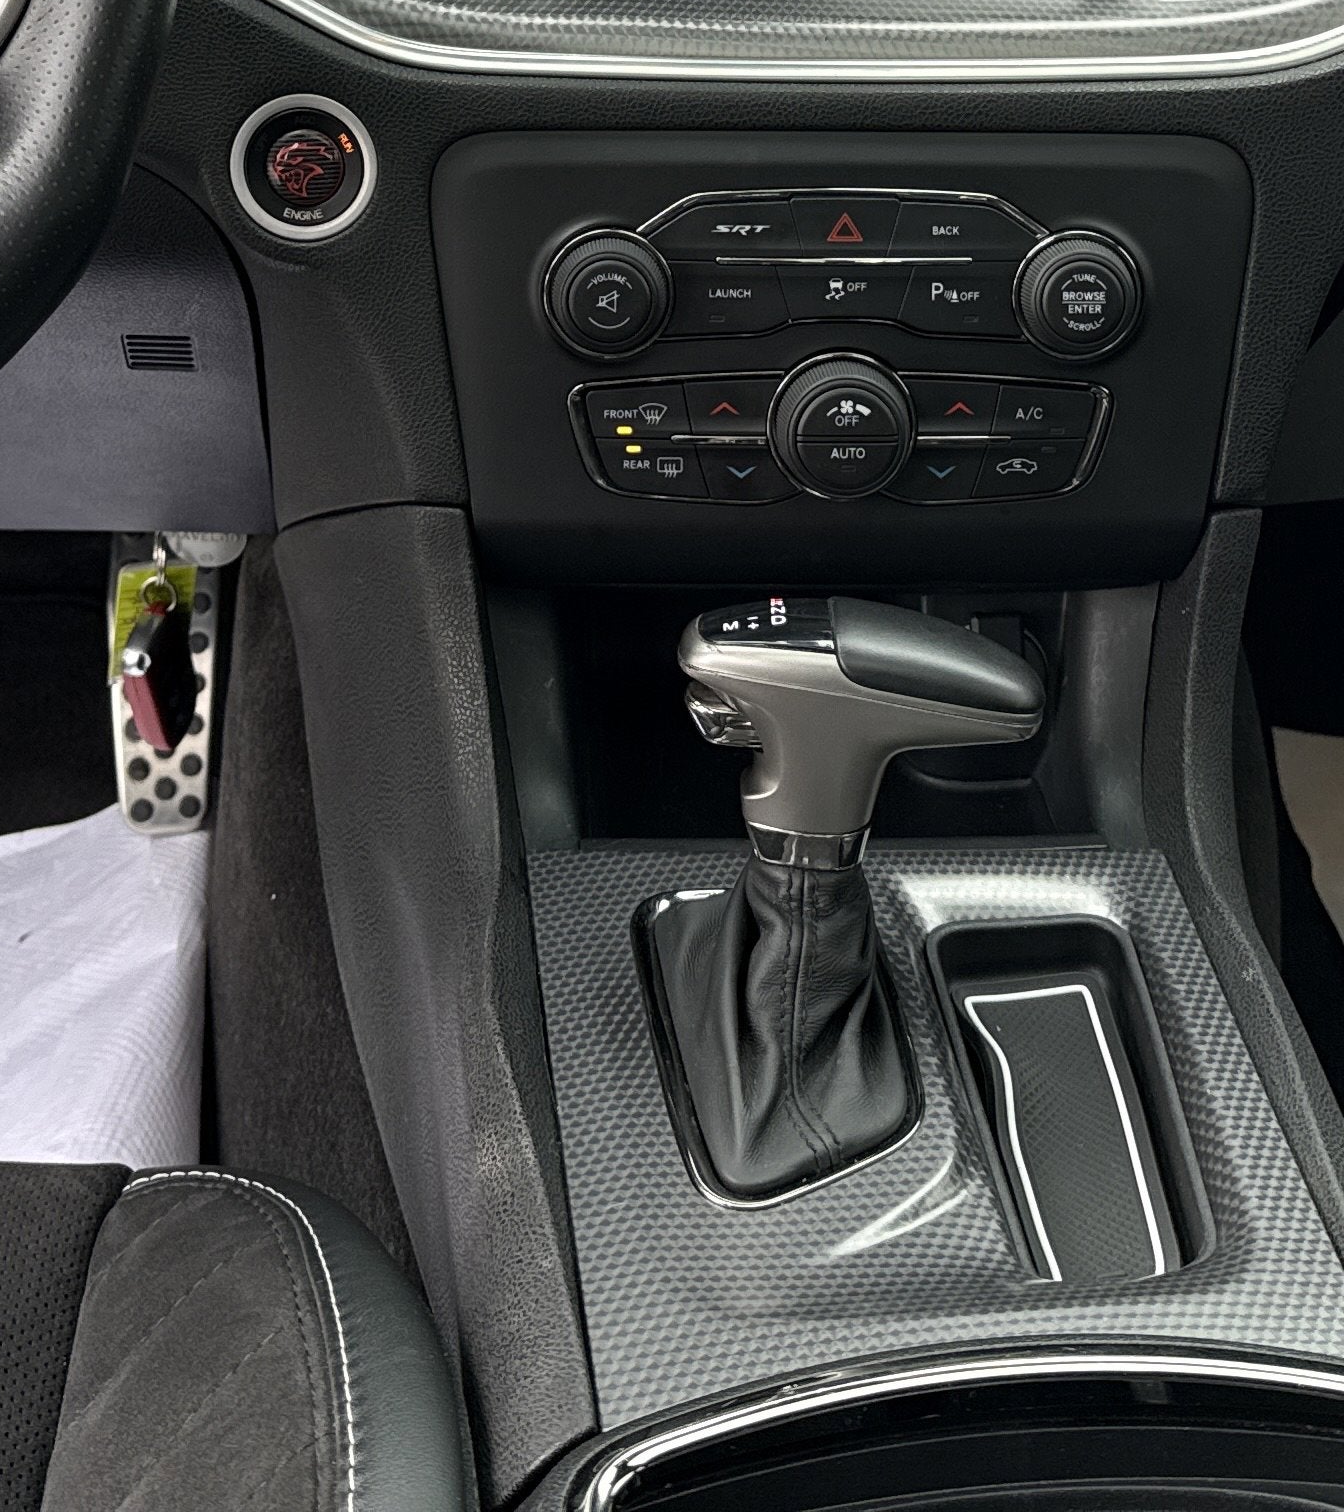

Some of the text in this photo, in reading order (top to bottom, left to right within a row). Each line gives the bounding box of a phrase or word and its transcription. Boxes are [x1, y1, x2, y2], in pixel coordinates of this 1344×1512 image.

[283, 208, 323, 220] ENGINE
[712, 225, 769, 235] SRT
[933, 226, 959, 235] BACK
[589, 273, 630, 287] VOLUME
[1070, 274, 1098, 283] TUNE
[847, 283, 866, 291] OFF
[709, 289, 751, 298] LAUNCH
[958, 292, 979, 302] OFF
[1063, 292, 1106, 303] BROWSE
[1066, 301, 1104, 313] ENTER
[1065, 318, 1103, 331] SCROLL
[604, 407, 640, 418] FRONT
[1016, 407, 1042, 420] A/C
[835, 413, 859, 426] OFF
[831, 448, 865, 458] AUTO
[624, 460, 650, 469] REAR
